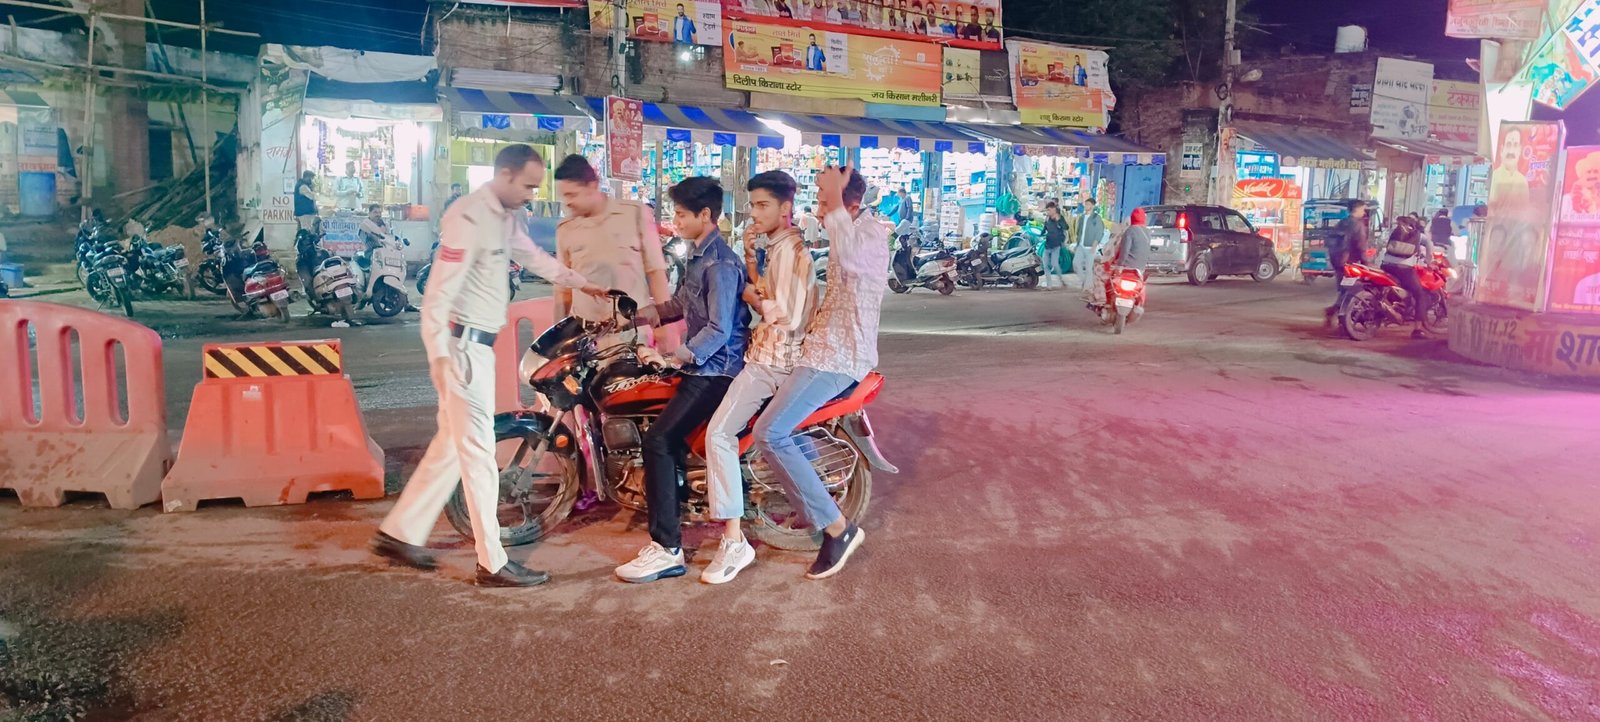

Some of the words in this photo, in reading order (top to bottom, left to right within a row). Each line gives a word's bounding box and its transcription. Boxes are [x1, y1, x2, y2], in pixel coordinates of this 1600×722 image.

[732, 74, 757, 86] दिलीप
[758, 77, 784, 89] किराना
[786, 81, 803, 91] स्टोर
[871, 90, 885, 98] जय
[886, 90, 910, 100] किसान
[272, 196, 290, 206] NO
